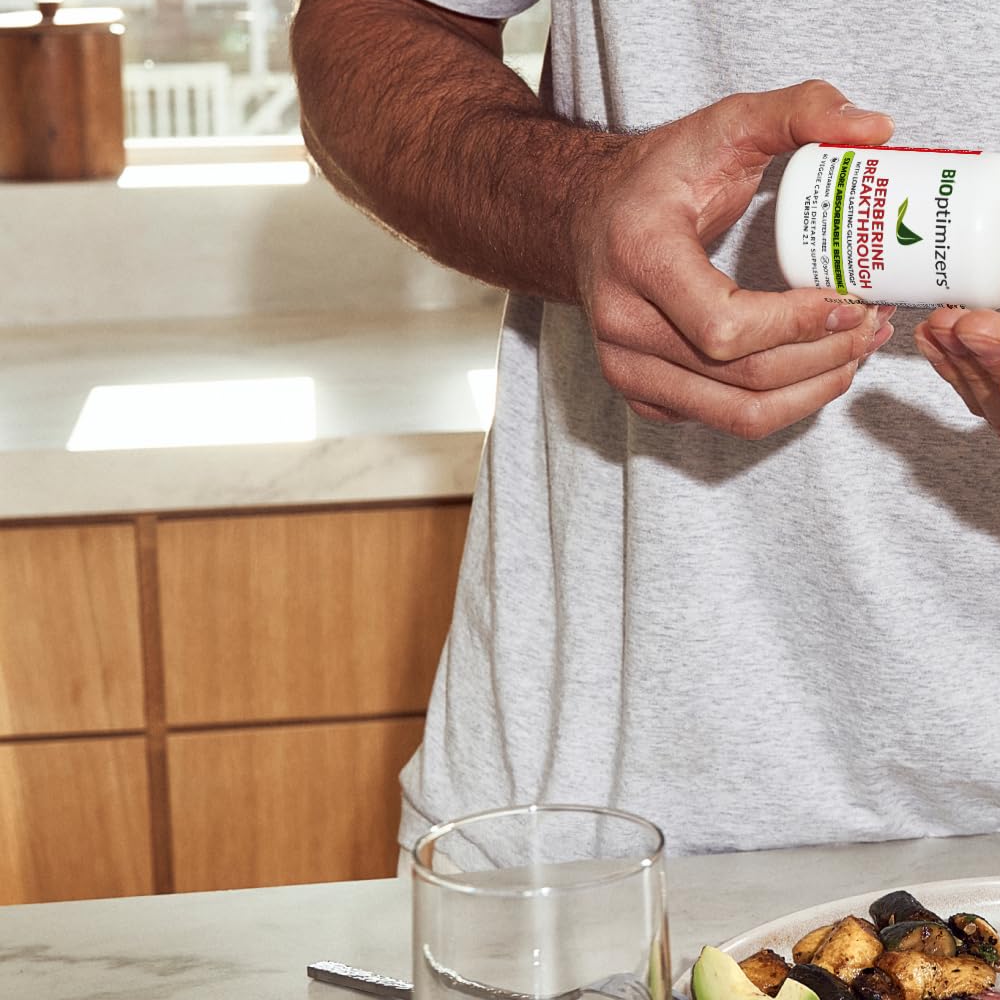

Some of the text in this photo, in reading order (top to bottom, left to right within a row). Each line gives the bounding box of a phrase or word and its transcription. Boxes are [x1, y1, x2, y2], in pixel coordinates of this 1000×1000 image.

[815, 160, 826, 183] VEGGIE
[850, 176, 858, 195] LONG
[833, 157, 851, 289] 5X MORE ABSORBABLE BERBERINE
[847, 196, 855, 229] LASTING
[856, 159, 879, 289] BREAKTHROUGH
[871, 177, 889, 271] BERBERINE
[810, 248, 821, 290] SUPPLEMENT
